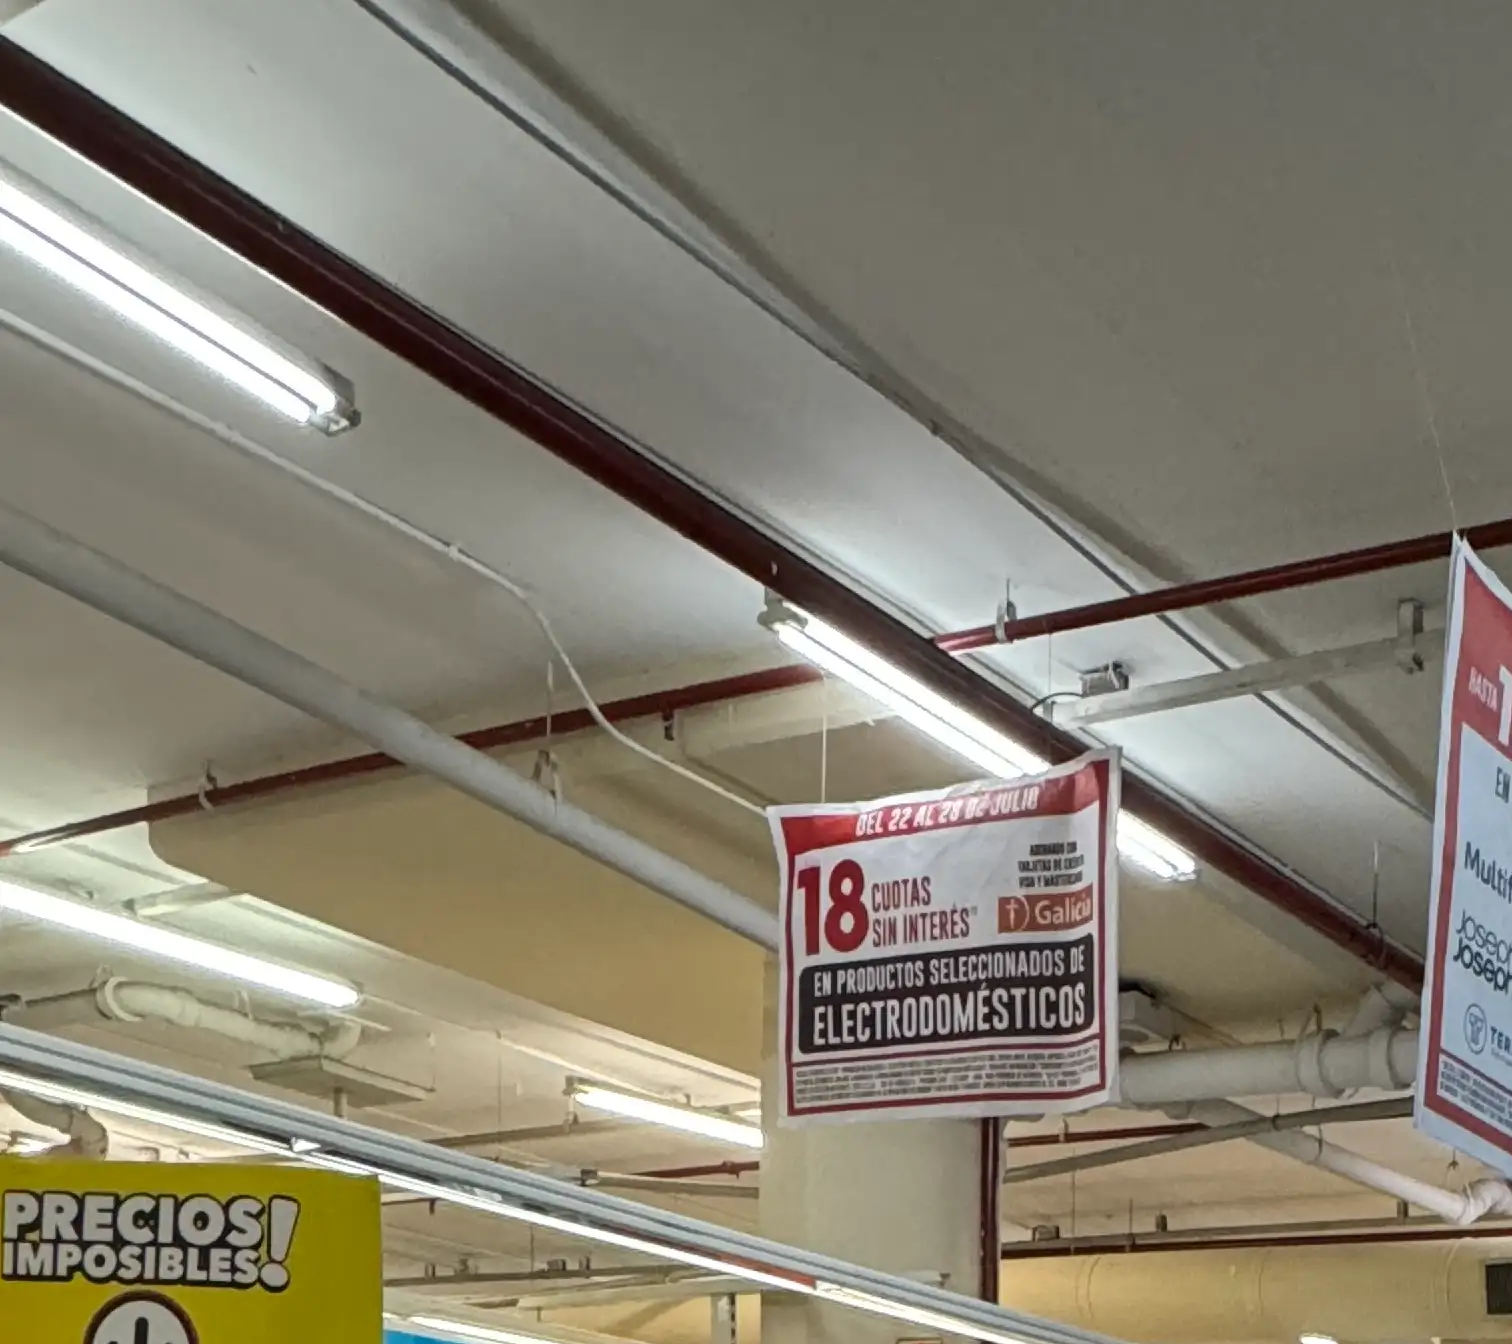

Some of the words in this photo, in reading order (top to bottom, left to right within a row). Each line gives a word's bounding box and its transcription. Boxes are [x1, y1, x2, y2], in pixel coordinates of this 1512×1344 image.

[1495, 766, 1510, 804] EN
[856, 812, 884, 837] DEL
[888, 806, 913, 832] 22
[913, 803, 936, 828] AL
[990, 786, 1040, 816] JULIO
[797, 859, 870, 956] 18
[871, 876, 932, 913] CUOTAS
[872, 915, 897, 948] SIN
[902, 904, 971, 944] INTERÉS
[813, 970, 832, 998] EN
[836, 962, 925, 994] PRODUCTOS
[929, 950, 1065, 986] SELECCIONADOS
[1069, 944, 1086, 973] DE
[812, 980, 1087, 1047] ELECTRODOMÉSTICOS
[3, 1190, 266, 1249] PRECIOS
